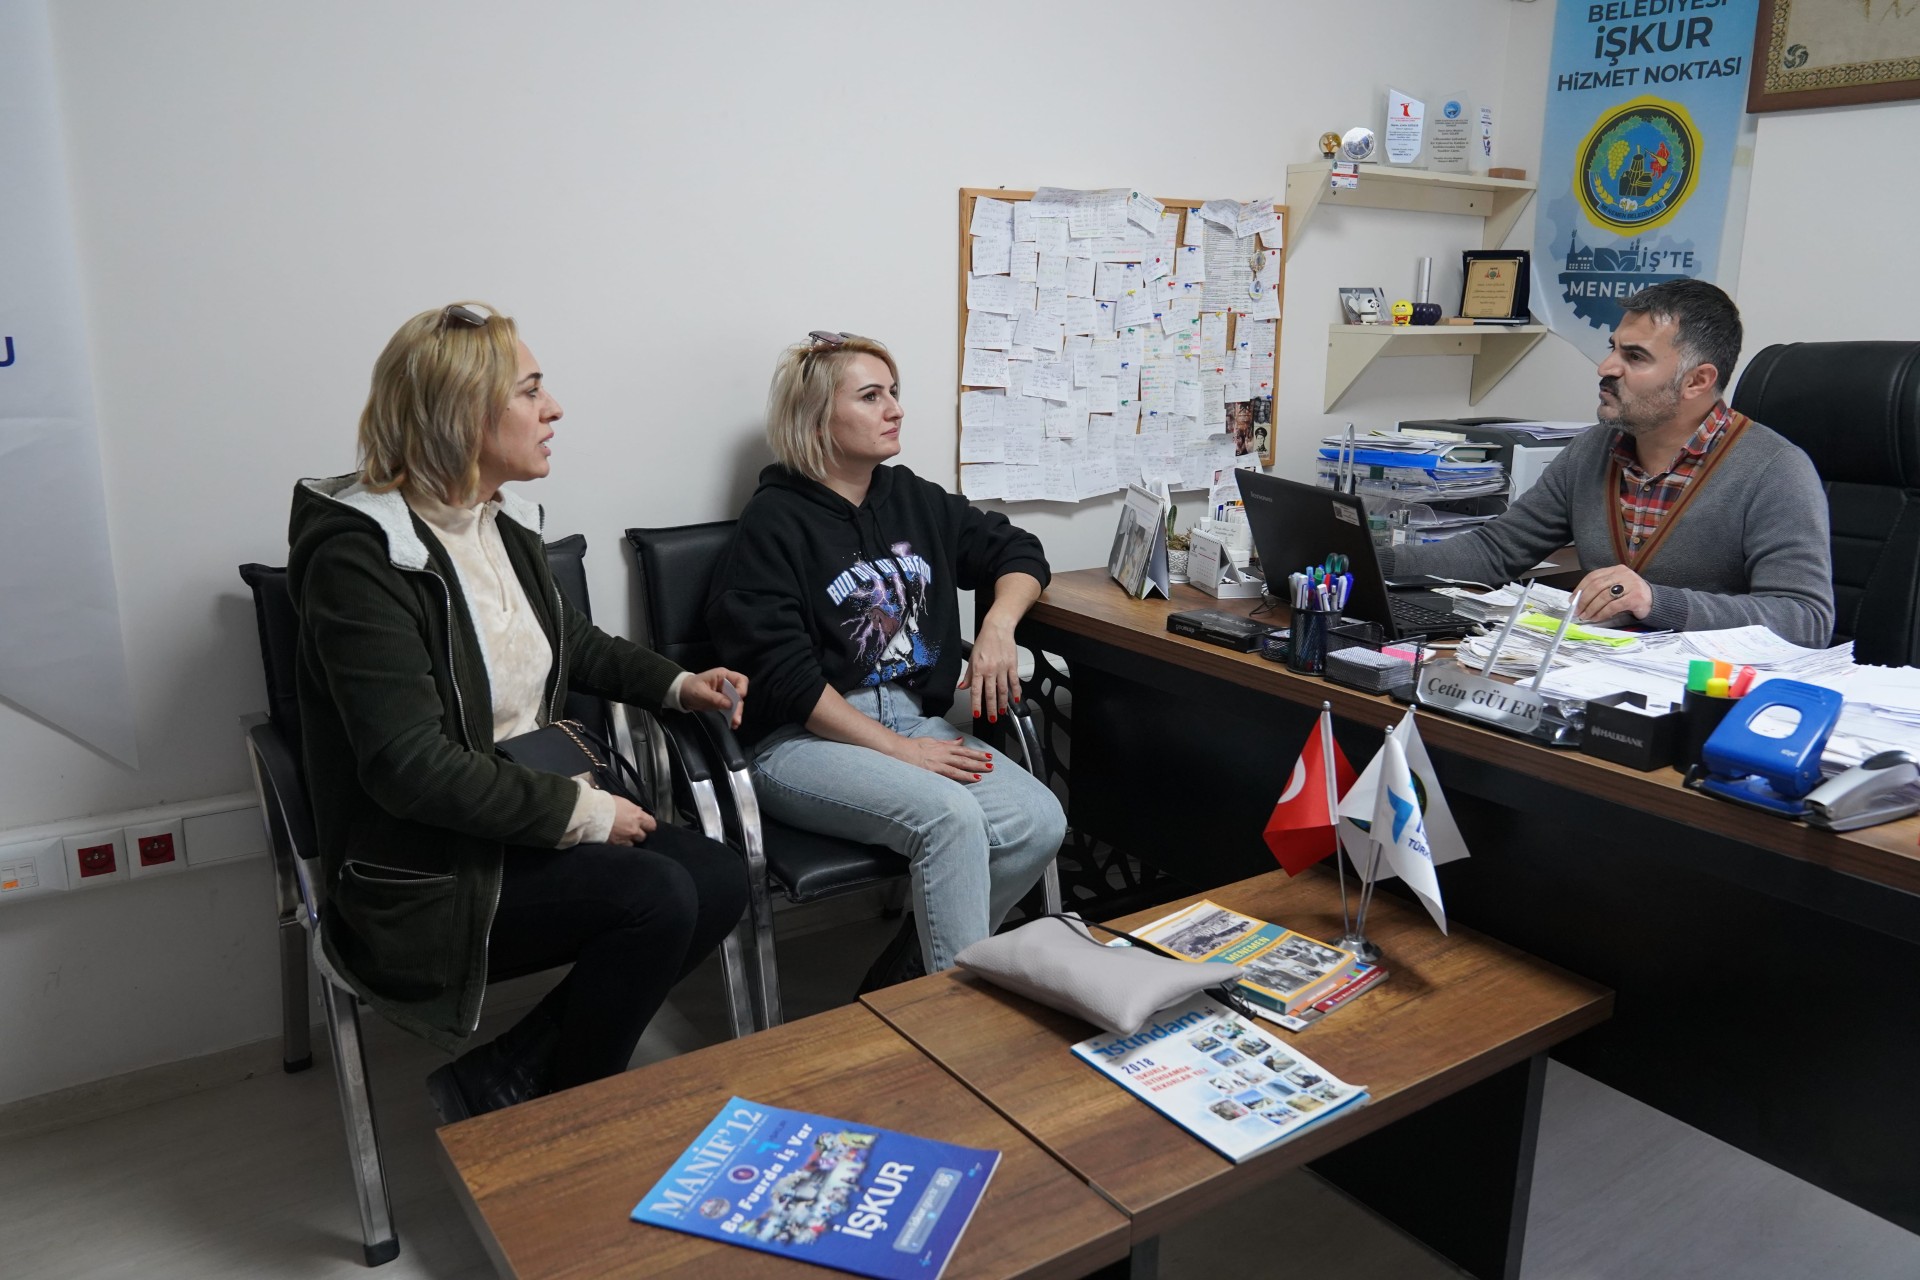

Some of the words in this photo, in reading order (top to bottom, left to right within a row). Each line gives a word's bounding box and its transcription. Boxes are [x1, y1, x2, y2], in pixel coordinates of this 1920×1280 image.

[1643, 56, 1743, 85] NOKTASI
[1569, 280, 1660, 298] MENEM
[826, 570, 858, 606] RUN
[1427, 677, 1468, 701] Çetin
[1471, 689, 1538, 720] GÜLER
[1121, 1057, 1155, 1075] 2018
[720, 1212, 745, 1234] Bu
[738, 1162, 784, 1211] Fuarda
[786, 1123, 813, 1147] Var
